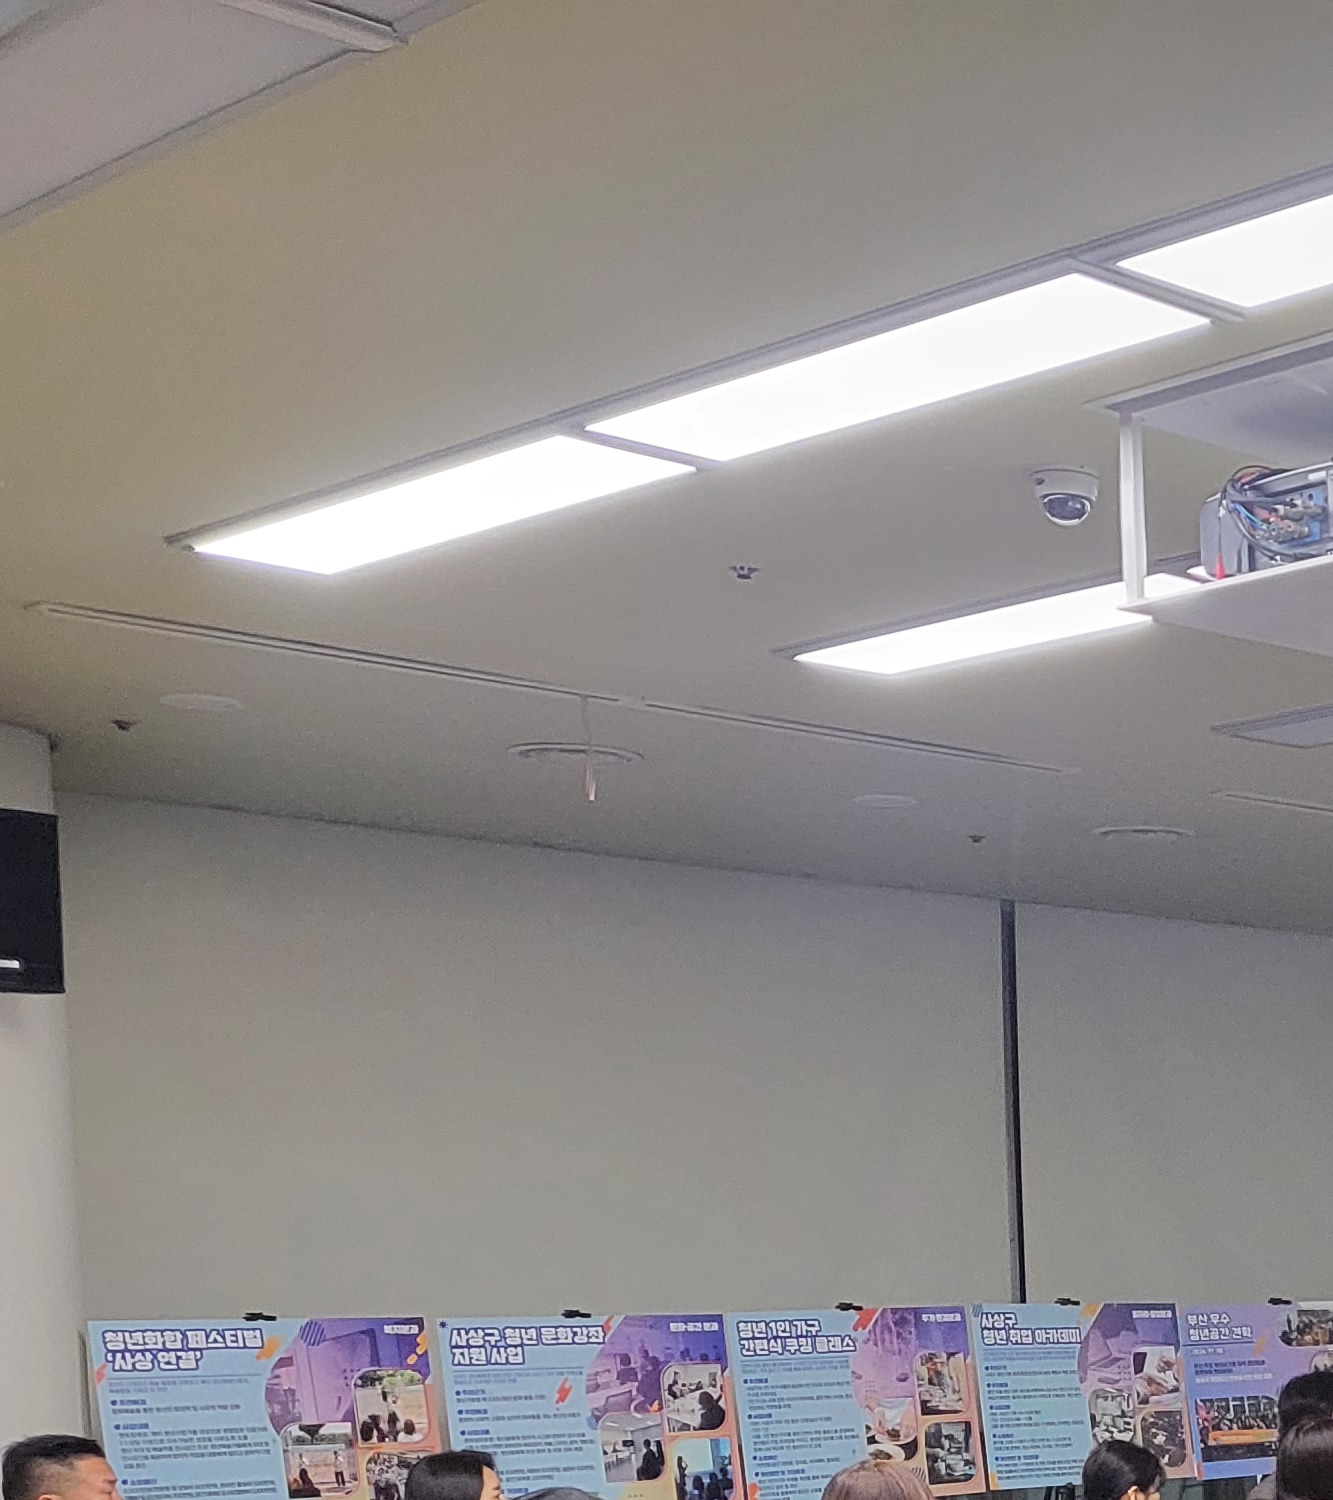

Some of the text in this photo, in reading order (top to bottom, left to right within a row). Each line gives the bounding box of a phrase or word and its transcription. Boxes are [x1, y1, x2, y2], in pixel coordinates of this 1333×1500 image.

[738, 1320, 821, 1337] 청년 1인 가구
[981, 1313, 1017, 1328] 사상구
[1187, 1314, 1208, 1326] 부산
[102, 1329, 264, 1350] 청년화합 페스티벌
[451, 1327, 605, 1346] 사상구 청년 문화강좌
[983, 1328, 1081, 1344] 청년 취업 아카데미
[1189, 1327, 1230, 1340] 청년공간
[740, 1336, 857, 1355] 간편식 쿠킹 클래스
[452, 1348, 524, 1365] 지원 사업
